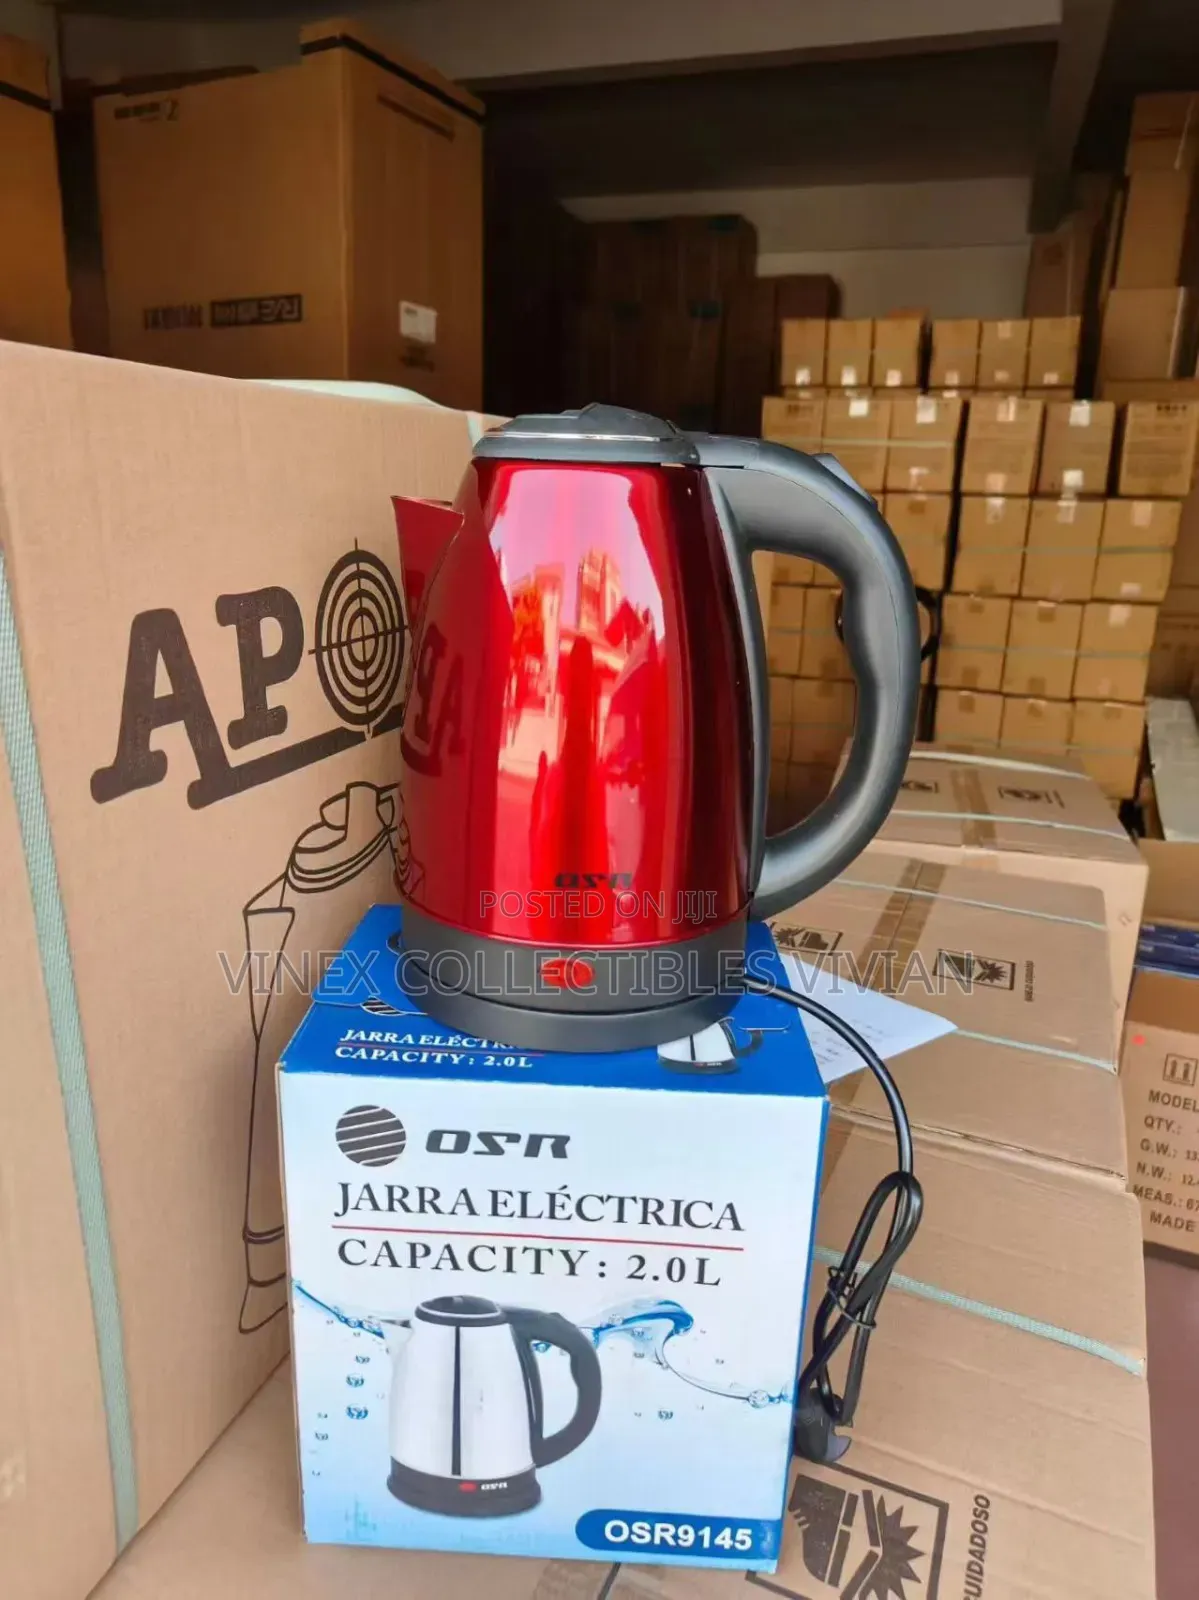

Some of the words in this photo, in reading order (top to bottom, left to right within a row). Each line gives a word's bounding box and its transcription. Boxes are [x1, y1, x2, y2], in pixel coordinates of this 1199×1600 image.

[555, 872, 632, 888] OSR
[341, 1029, 415, 1044] JARRA
[483, 1055, 533, 1068] 2.0L
[425, 1129, 571, 1159] OSR
[334, 1182, 479, 1217] JARRA
[489, 1185, 745, 1232] ELÉCTRICA
[1150, 1210, 1196, 1232] MADE
[626, 1254, 721, 1286] 2.0L
[604, 1519, 753, 1551] OSR9145
